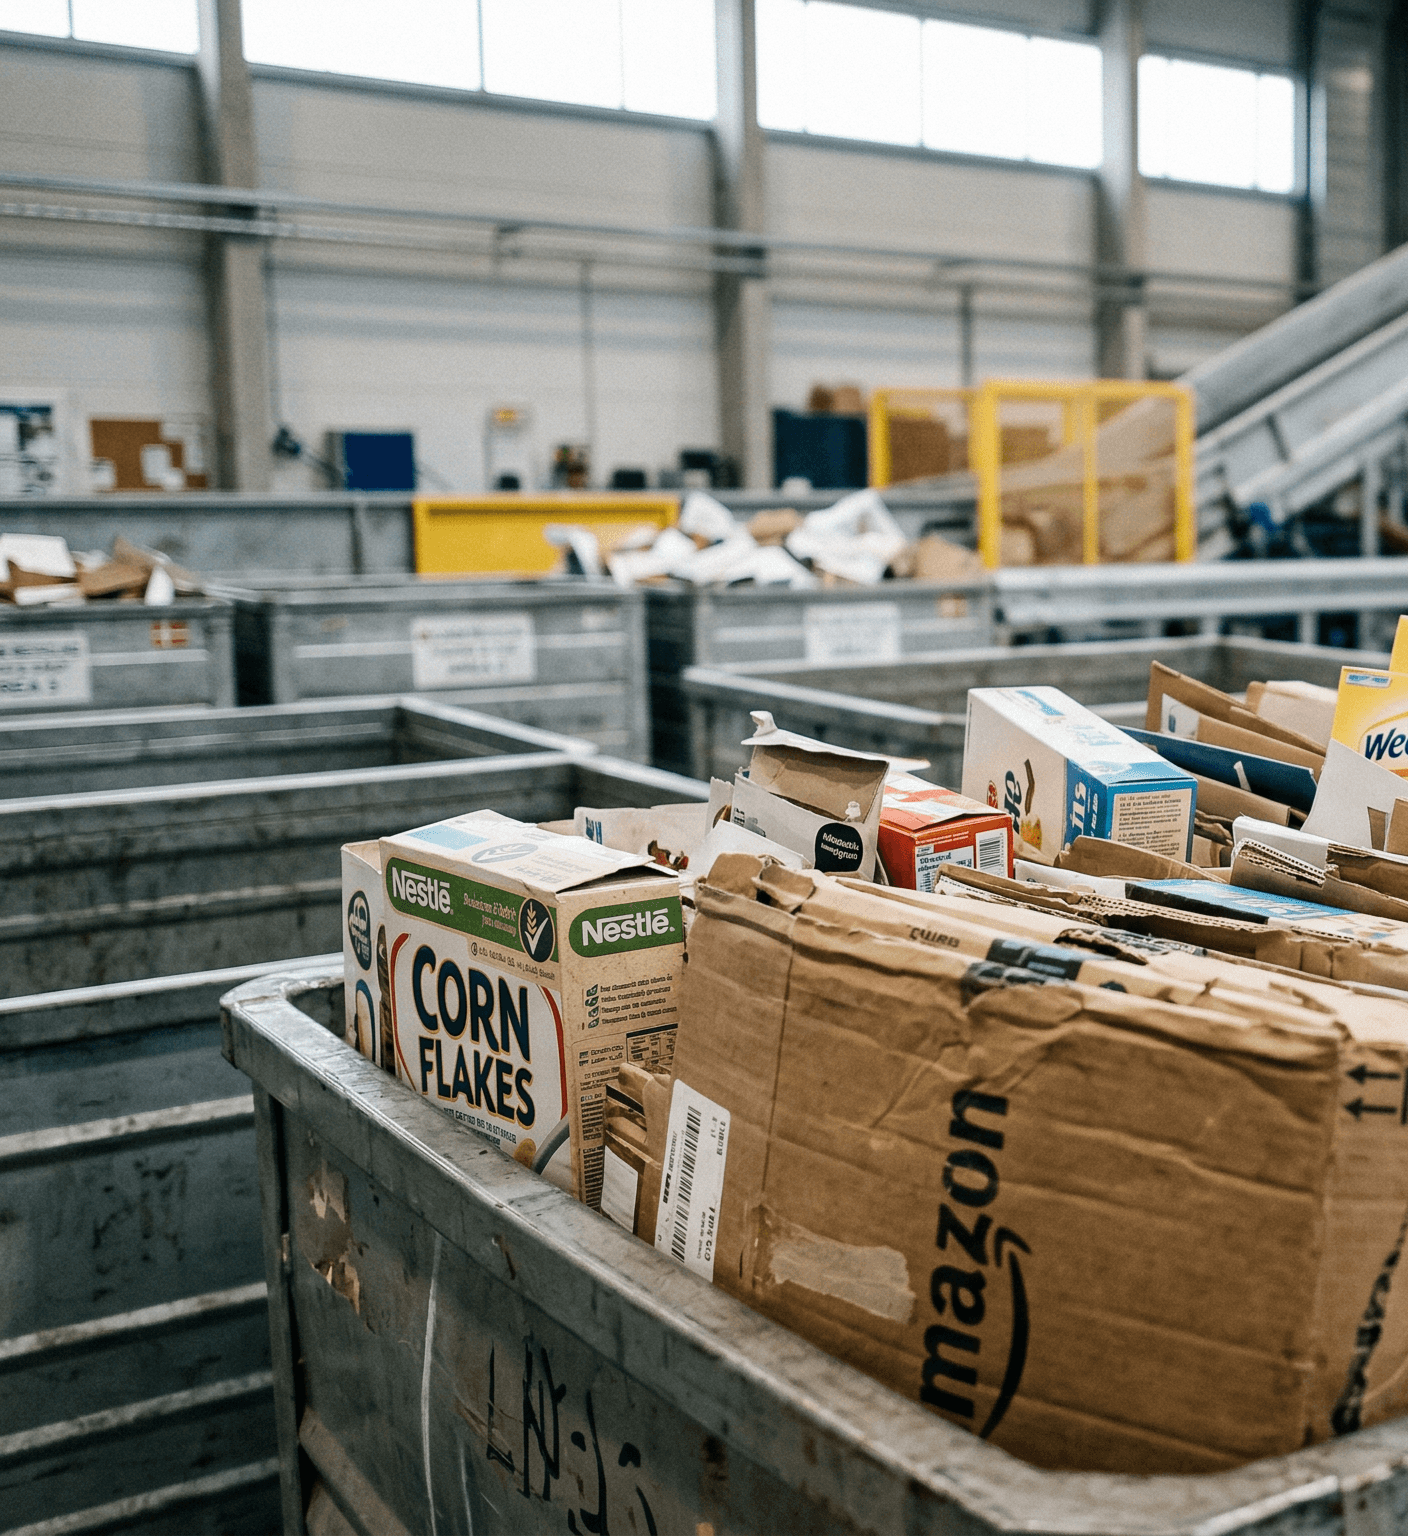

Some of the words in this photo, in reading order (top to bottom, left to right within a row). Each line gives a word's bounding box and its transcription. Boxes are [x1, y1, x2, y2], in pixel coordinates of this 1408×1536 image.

[412, 943, 531, 1064] CORN
[418, 1034, 536, 1131] FLAKES
[919, 1089, 1010, 1419] mazon
